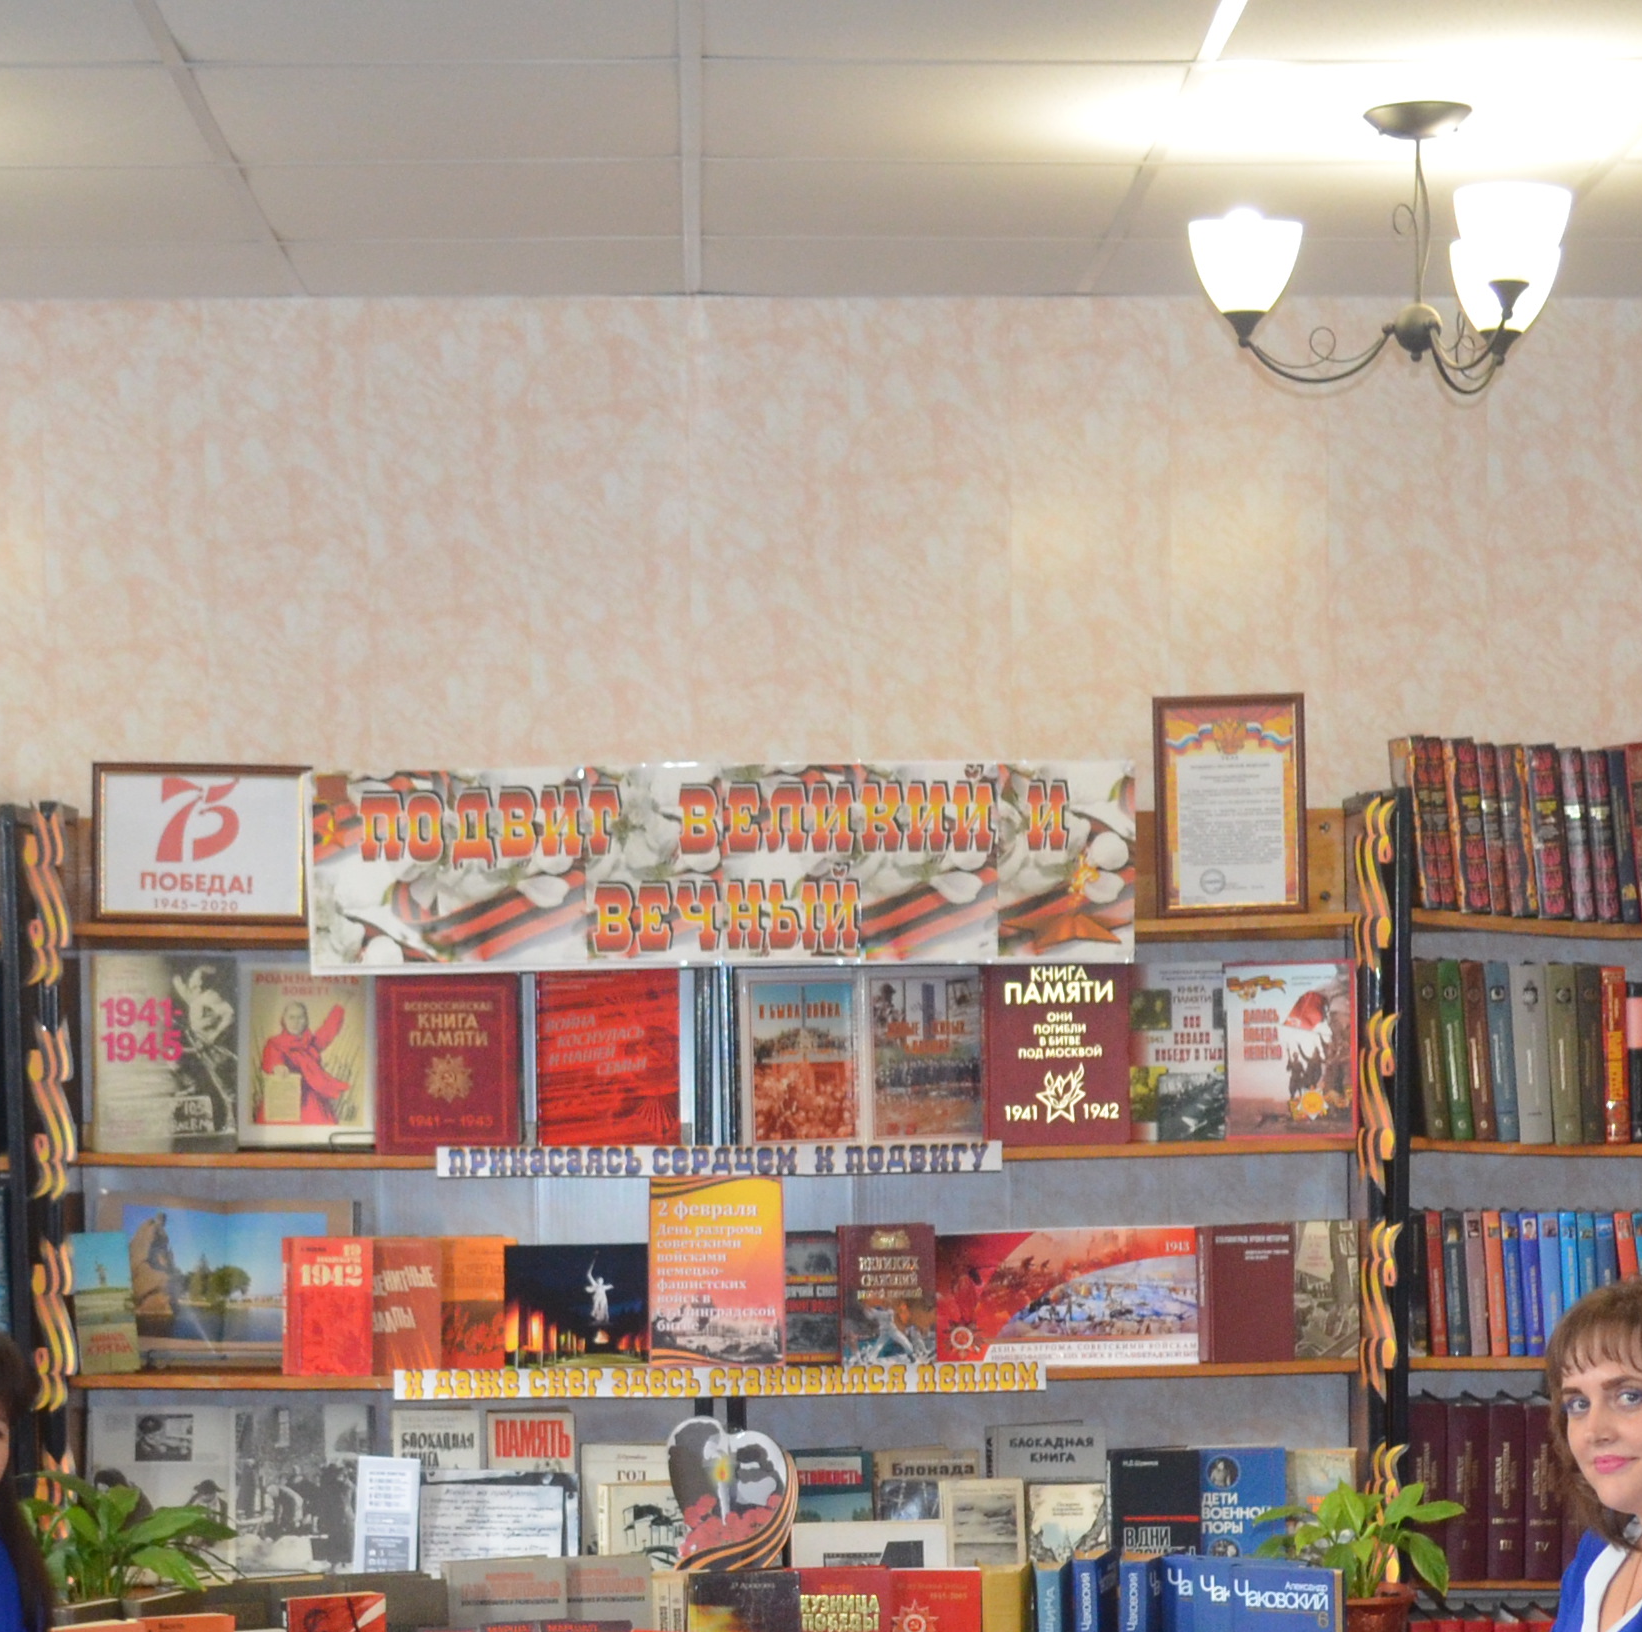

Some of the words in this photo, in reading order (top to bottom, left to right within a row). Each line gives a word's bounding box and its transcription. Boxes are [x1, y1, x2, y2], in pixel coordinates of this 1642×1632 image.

[358, 785, 620, 870] ПОДВИГ
[678, 763, 998, 856] ВЕЛИКИЙ
[1027, 779, 1071, 854] И
[141, 871, 253, 896] ПОБЕДА!
[592, 862, 862, 954] ВЕЧНЫЙ
[1030, 965, 1089, 982] КНИГА
[1004, 979, 1115, 1006] ПАМЯТИ
[99, 996, 184, 1028] 1941-
[1046, 1011, 1073, 1024] ОНИ
[417, 1013, 478, 1030] КНИГА
[545, 1012, 596, 1033] ВОЙНА
[1033, 1023, 1087, 1036] ПОГИБЛИ
[409, 1030, 489, 1047] ПАМЯТИ
[557, 1024, 646, 1048] КОСНУЛАСЬ
[1039, 1036, 1047, 1047] В
[1049, 1035, 1081, 1046] БИТВЕ
[1243, 1026, 1279, 1042] ПОБЕДА
[100, 1031, 183, 1062] 1945
[1018, 1047, 1044, 1060] ПОД
[1046, 1044, 1103, 1059] МОСКВОЙ
[595, 1058, 648, 1076] СЕМЬИ
[1004, 1104, 1038, 1122] 1941
[1083, 1102, 1120, 1120] 1942
[657, 1201, 668, 1217] 2
[673, 1201, 758, 1219] февраля
[657, 1224, 693, 1239] День
[695, 1226, 763, 1239] разгрома
[657, 1238, 742, 1250] советскими
[1164, 1240, 1190, 1253] 1943
[657, 1251, 727, 1263] войсками
[859, 1256, 920, 1271] ВЕЛИКИХ
[299, 1264, 363, 1287] 1942
[657, 1265, 725, 1277] немецко-
[657, 1278, 747, 1291] фашистских
[657, 1292, 700, 1304] войск
[702, 1294, 712, 1304] в
[657, 1305, 777, 1319] Сталинградской
[401, 1431, 475, 1449] БЛОКАДНАЯ
[495, 1420, 572, 1459] ПАМЯТЬ
[1009, 1436, 1095, 1449] БЛОКАДНАЯ
[1030, 1451, 1076, 1463] КНИГА
[1201, 1492, 1238, 1507] ДЕТИ
[1201, 1520, 1243, 1534] ПОРЫ
[1123, 1527, 1134, 1547] В
[1136, 1526, 1171, 1547] ДНИ
[1233, 1578, 1329, 1611] Чаковский
[1284, 1580, 1329, 1594] Александр
[800, 1593, 880, 1613] КУЗНИЦА
[1081, 1571, 1092, 1632] Чаковский
[1126, 1571, 1139, 1632] Чаковский
[802, 1612, 879, 1632] ПОБЕДЫ
[1318, 1612, 1329, 1628] 6
